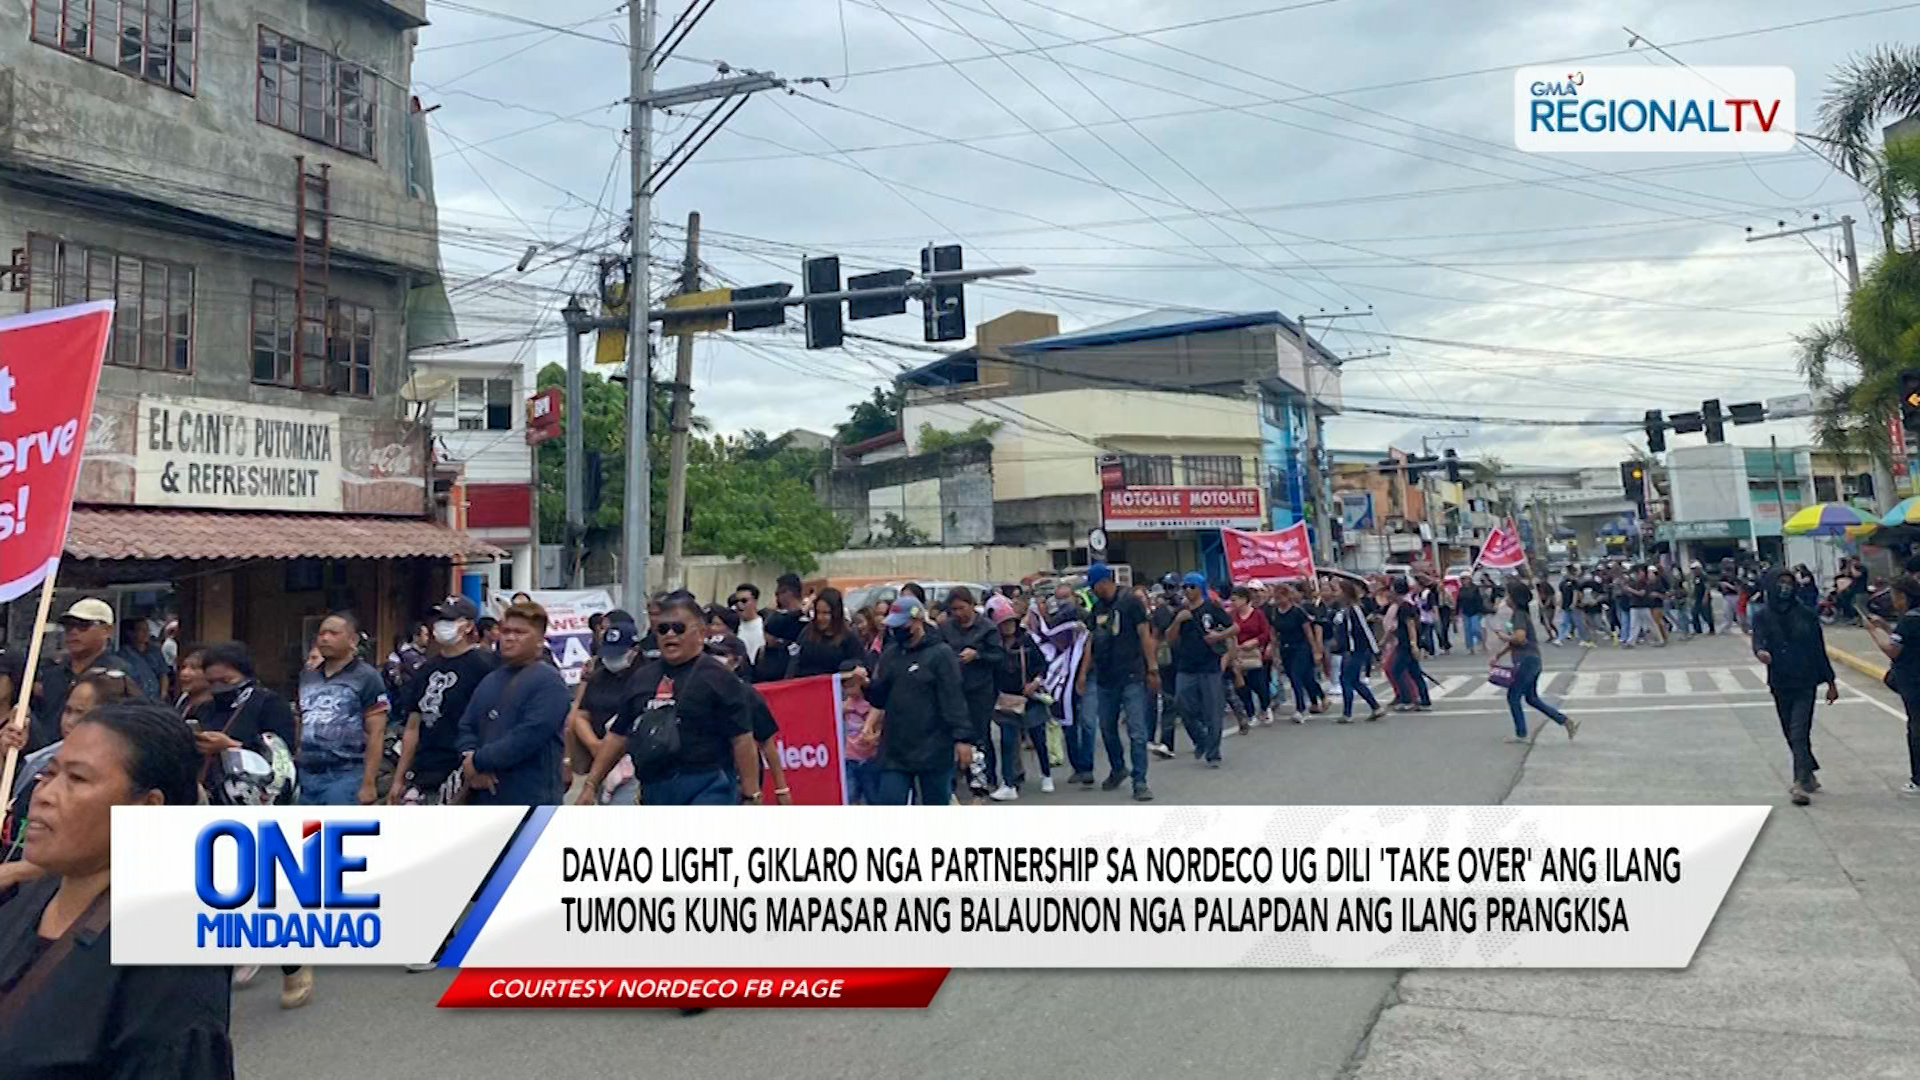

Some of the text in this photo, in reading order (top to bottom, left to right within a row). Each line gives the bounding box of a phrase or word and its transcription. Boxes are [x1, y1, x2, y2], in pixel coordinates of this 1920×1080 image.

[149, 407, 174, 450] EL
[178, 409, 247, 457] CANTO
[254, 417, 332, 462] PUTOMAYA
[161, 461, 319, 498] & REFRESHMENT
[1110, 491, 1181, 506] MOTOLITE
[1189, 491, 1255, 506] MOTOLITE
